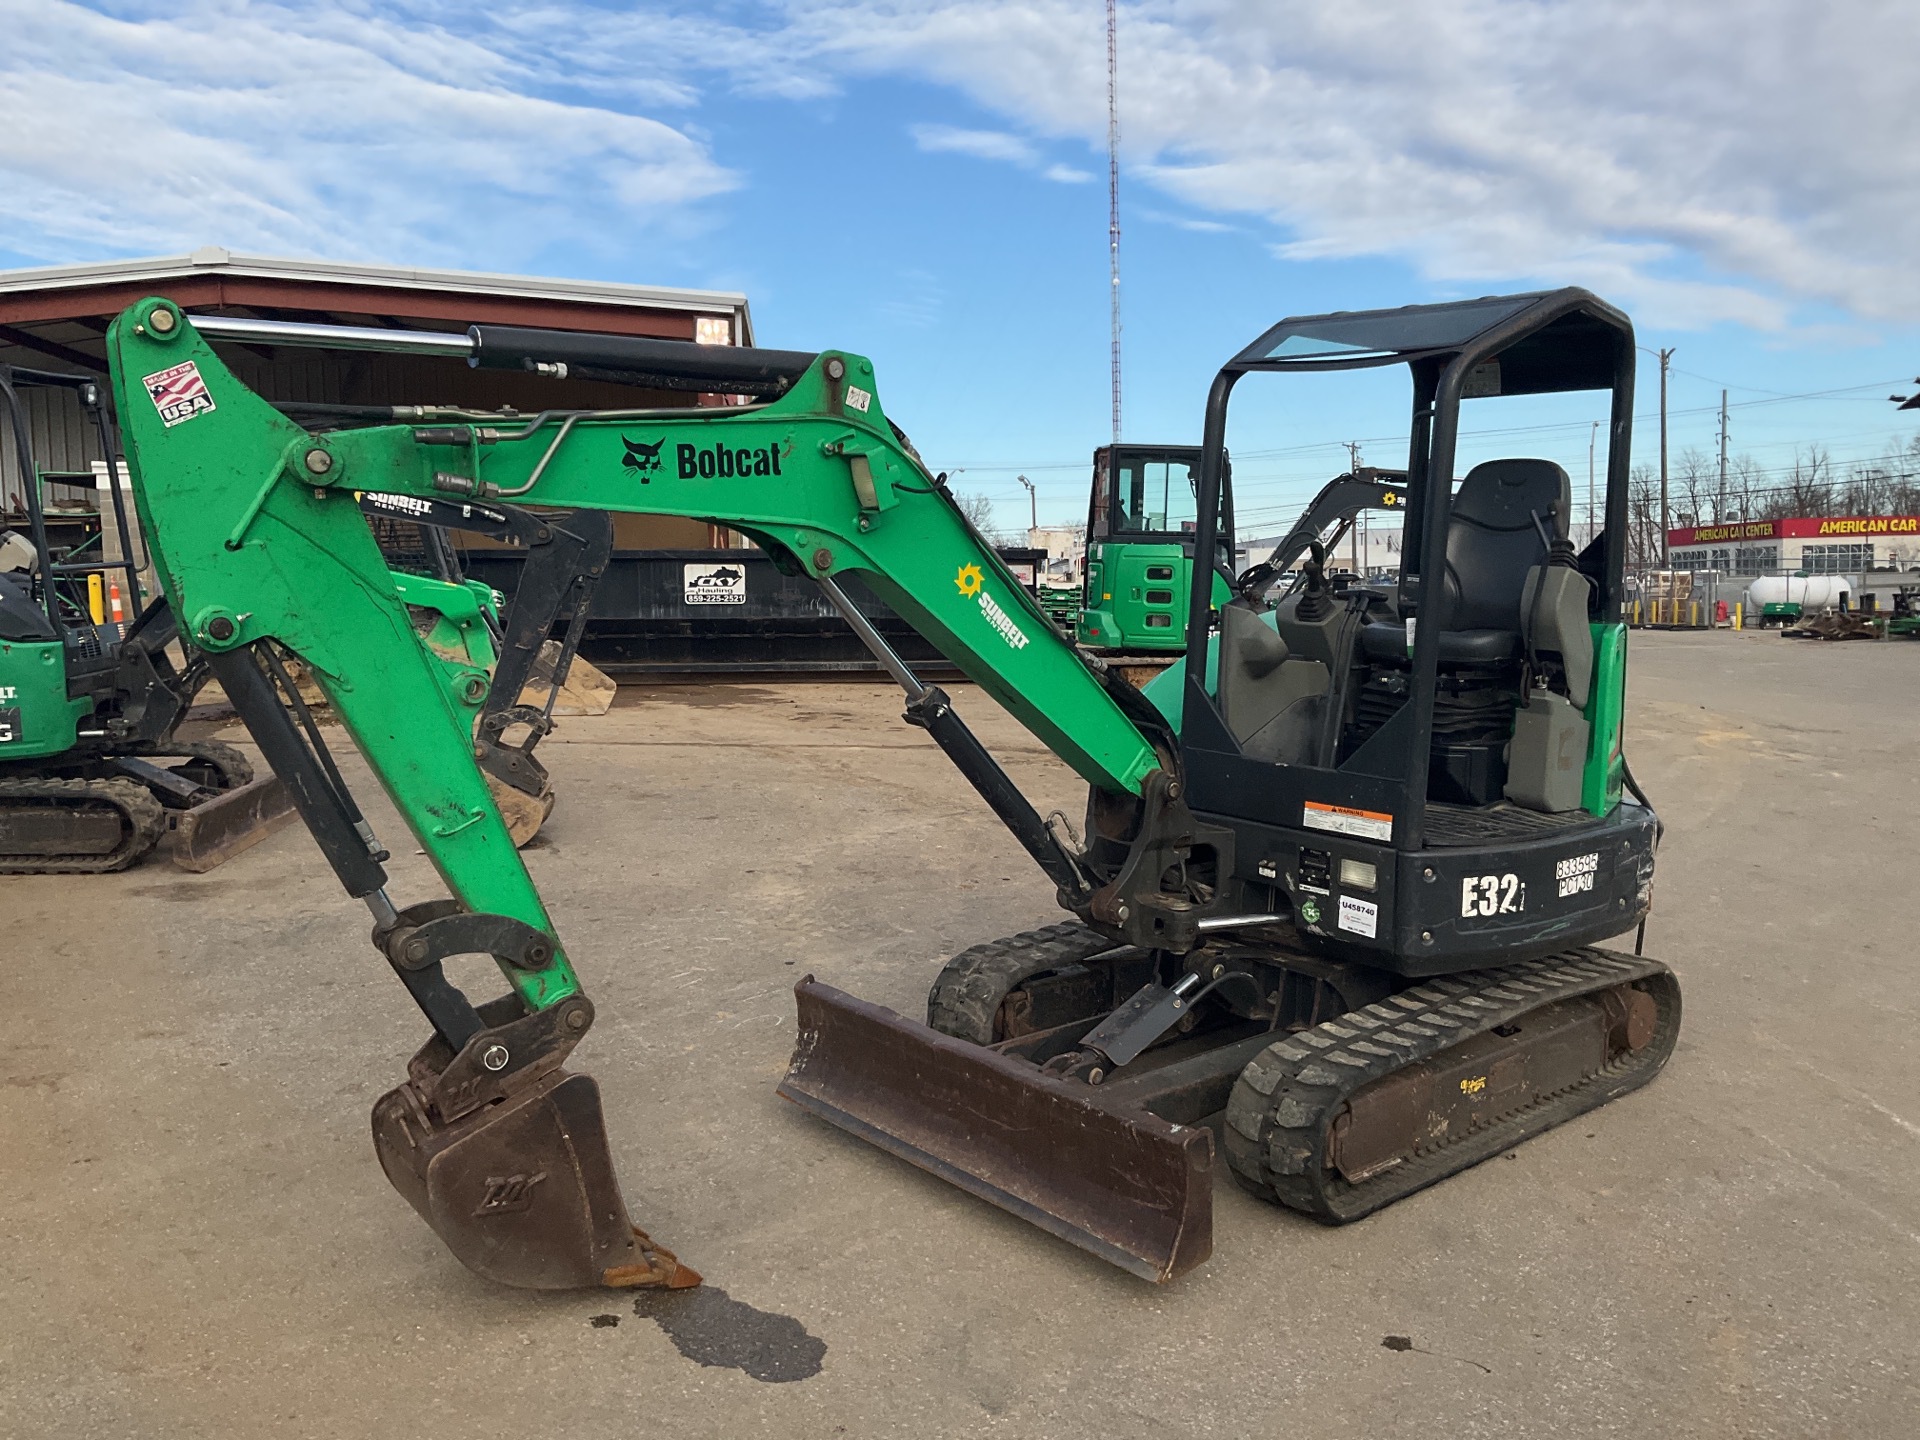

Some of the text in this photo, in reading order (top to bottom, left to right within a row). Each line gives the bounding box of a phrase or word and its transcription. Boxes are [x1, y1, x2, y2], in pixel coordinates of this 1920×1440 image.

[147, 373, 168, 384] MADE
[163, 396, 210, 420] USA
[676, 443, 782, 480] Bobcat
[367, 492, 432, 513] SUNBELT
[375, 502, 421, 517] RENTALS
[1694, 527, 1729, 541] AMERICAN
[1746, 523, 1774, 537] CENTER
[1820, 518, 1918, 534] AMERICAN CAR
[697, 587, 733, 595] Hauling
[978, 592, 1030, 650] SUNBELT
[981, 609, 1016, 649] RENTALS
[1338, 807, 1364, 817] WARNING
[1557, 854, 1598, 878] 833595
[1342, 901, 1375, 916] U458740
